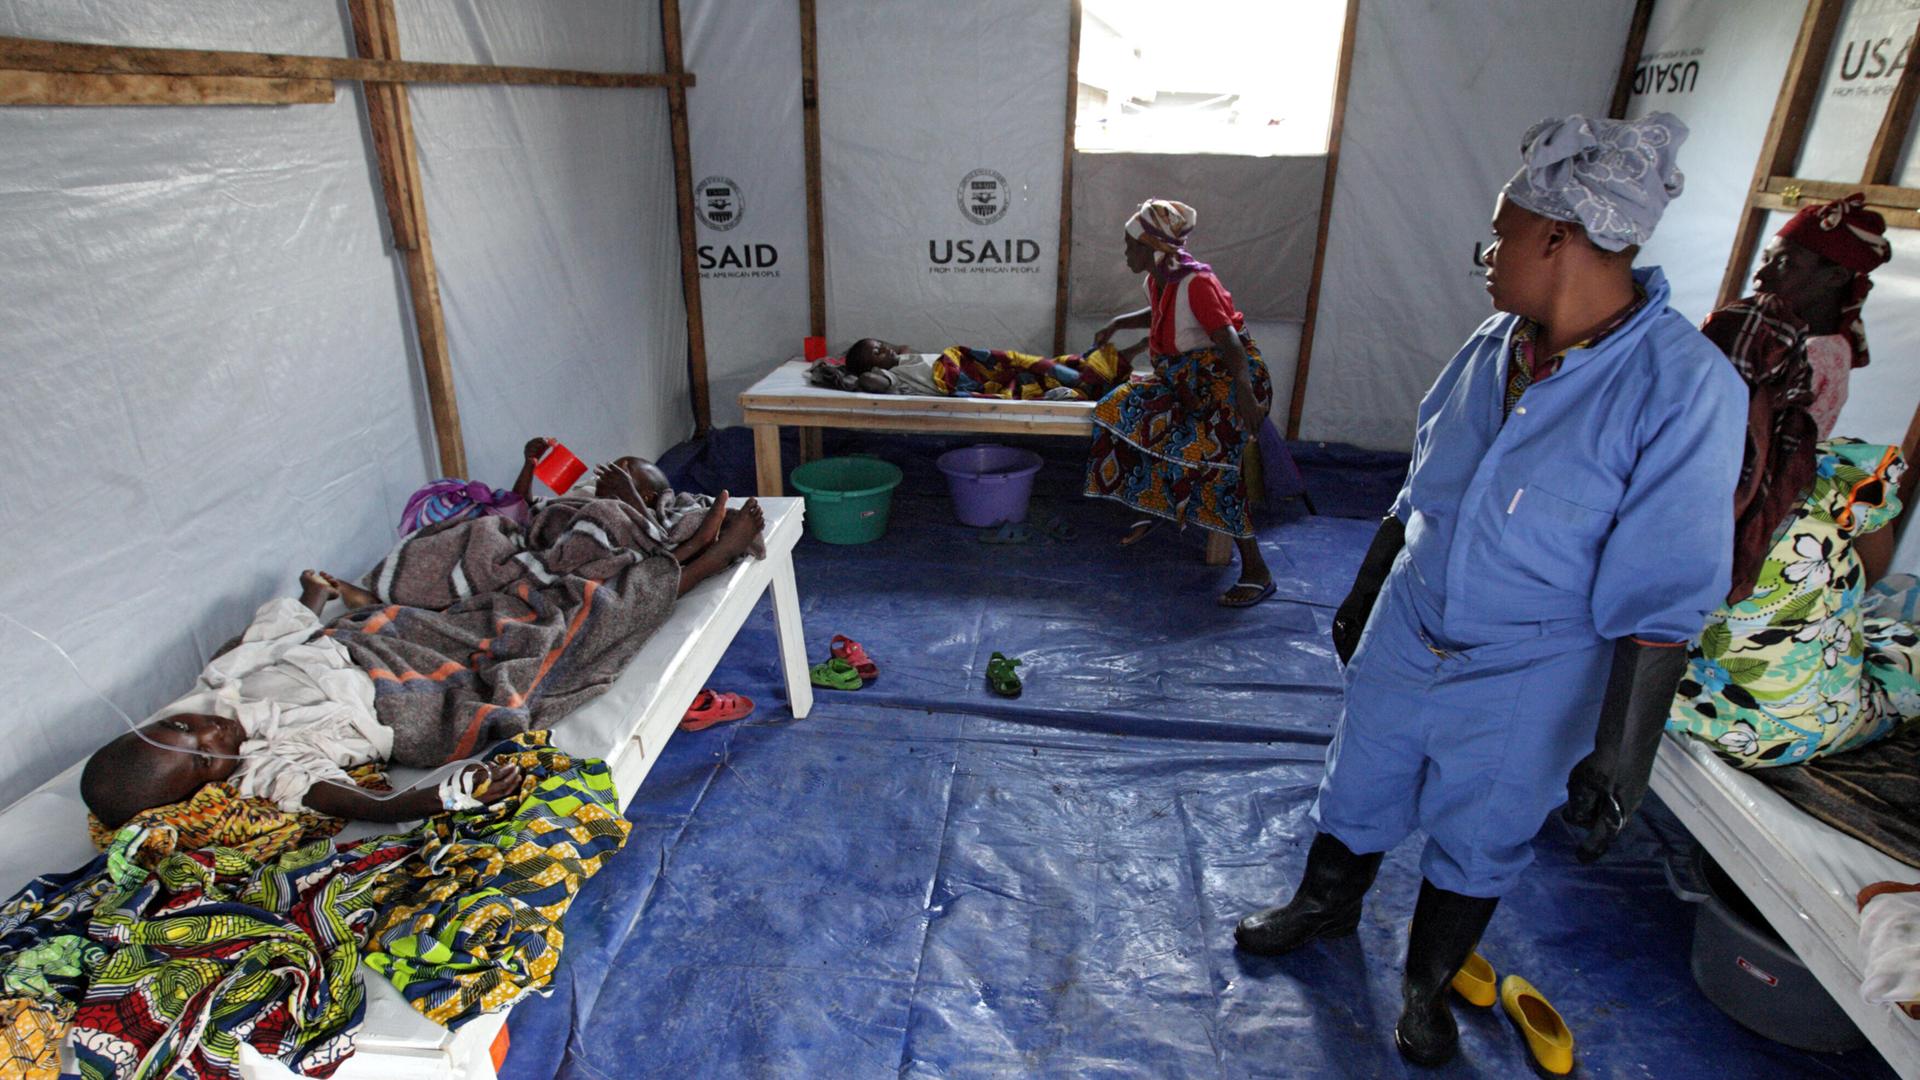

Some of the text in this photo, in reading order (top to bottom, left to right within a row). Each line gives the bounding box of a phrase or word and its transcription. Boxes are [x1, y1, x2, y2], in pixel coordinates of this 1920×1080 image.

[1841, 35, 1913, 80] USA
[1632, 60, 1699, 94] USAID
[698, 244, 778, 269] SAID
[929, 239, 1040, 264] USAID
[751, 270, 780, 278] PEOPLE
[929, 266, 1040, 274] FROM THE AMERICAN PEOPLE
